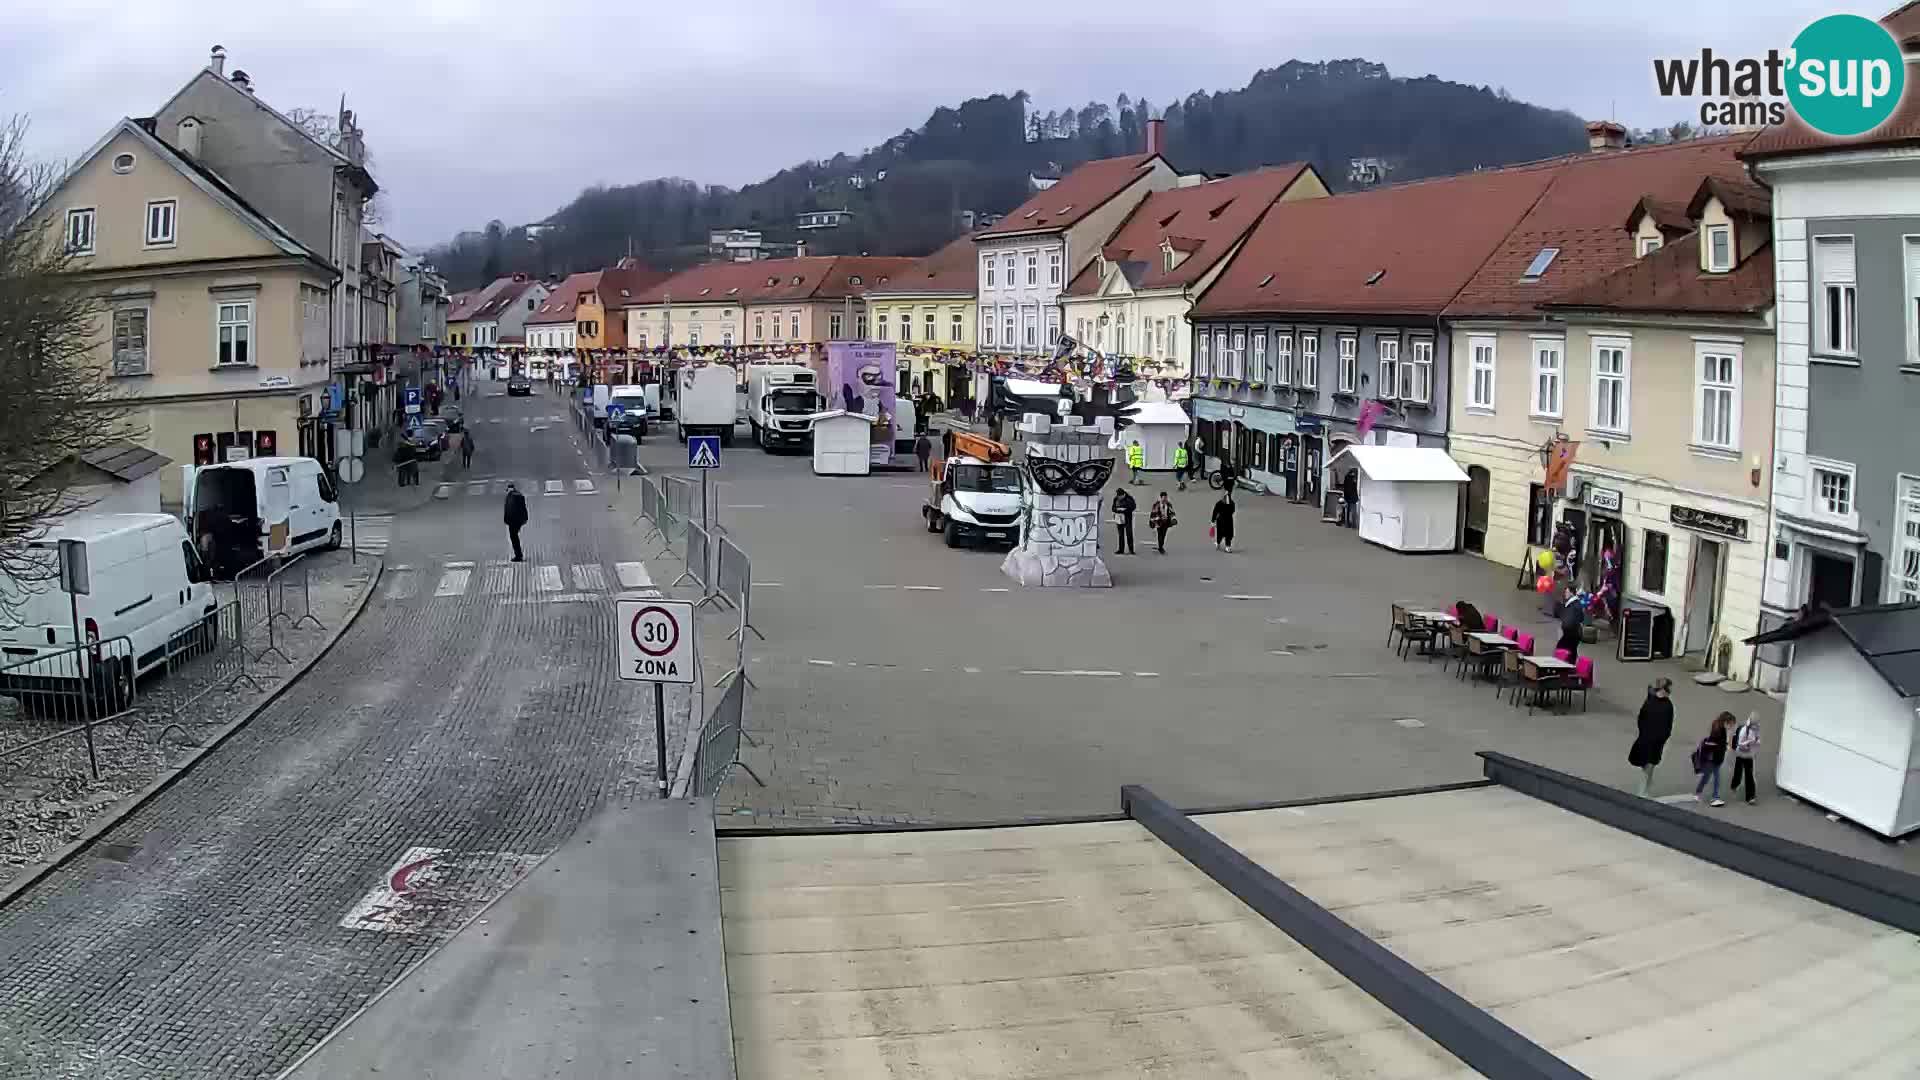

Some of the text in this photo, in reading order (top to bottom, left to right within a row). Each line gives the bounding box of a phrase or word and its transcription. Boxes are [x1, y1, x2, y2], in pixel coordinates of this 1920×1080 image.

[408, 391, 417, 402] P
[1047, 515, 1087, 545] 200
[644, 622, 667, 643] 30
[634, 659, 679, 676] ZONA
